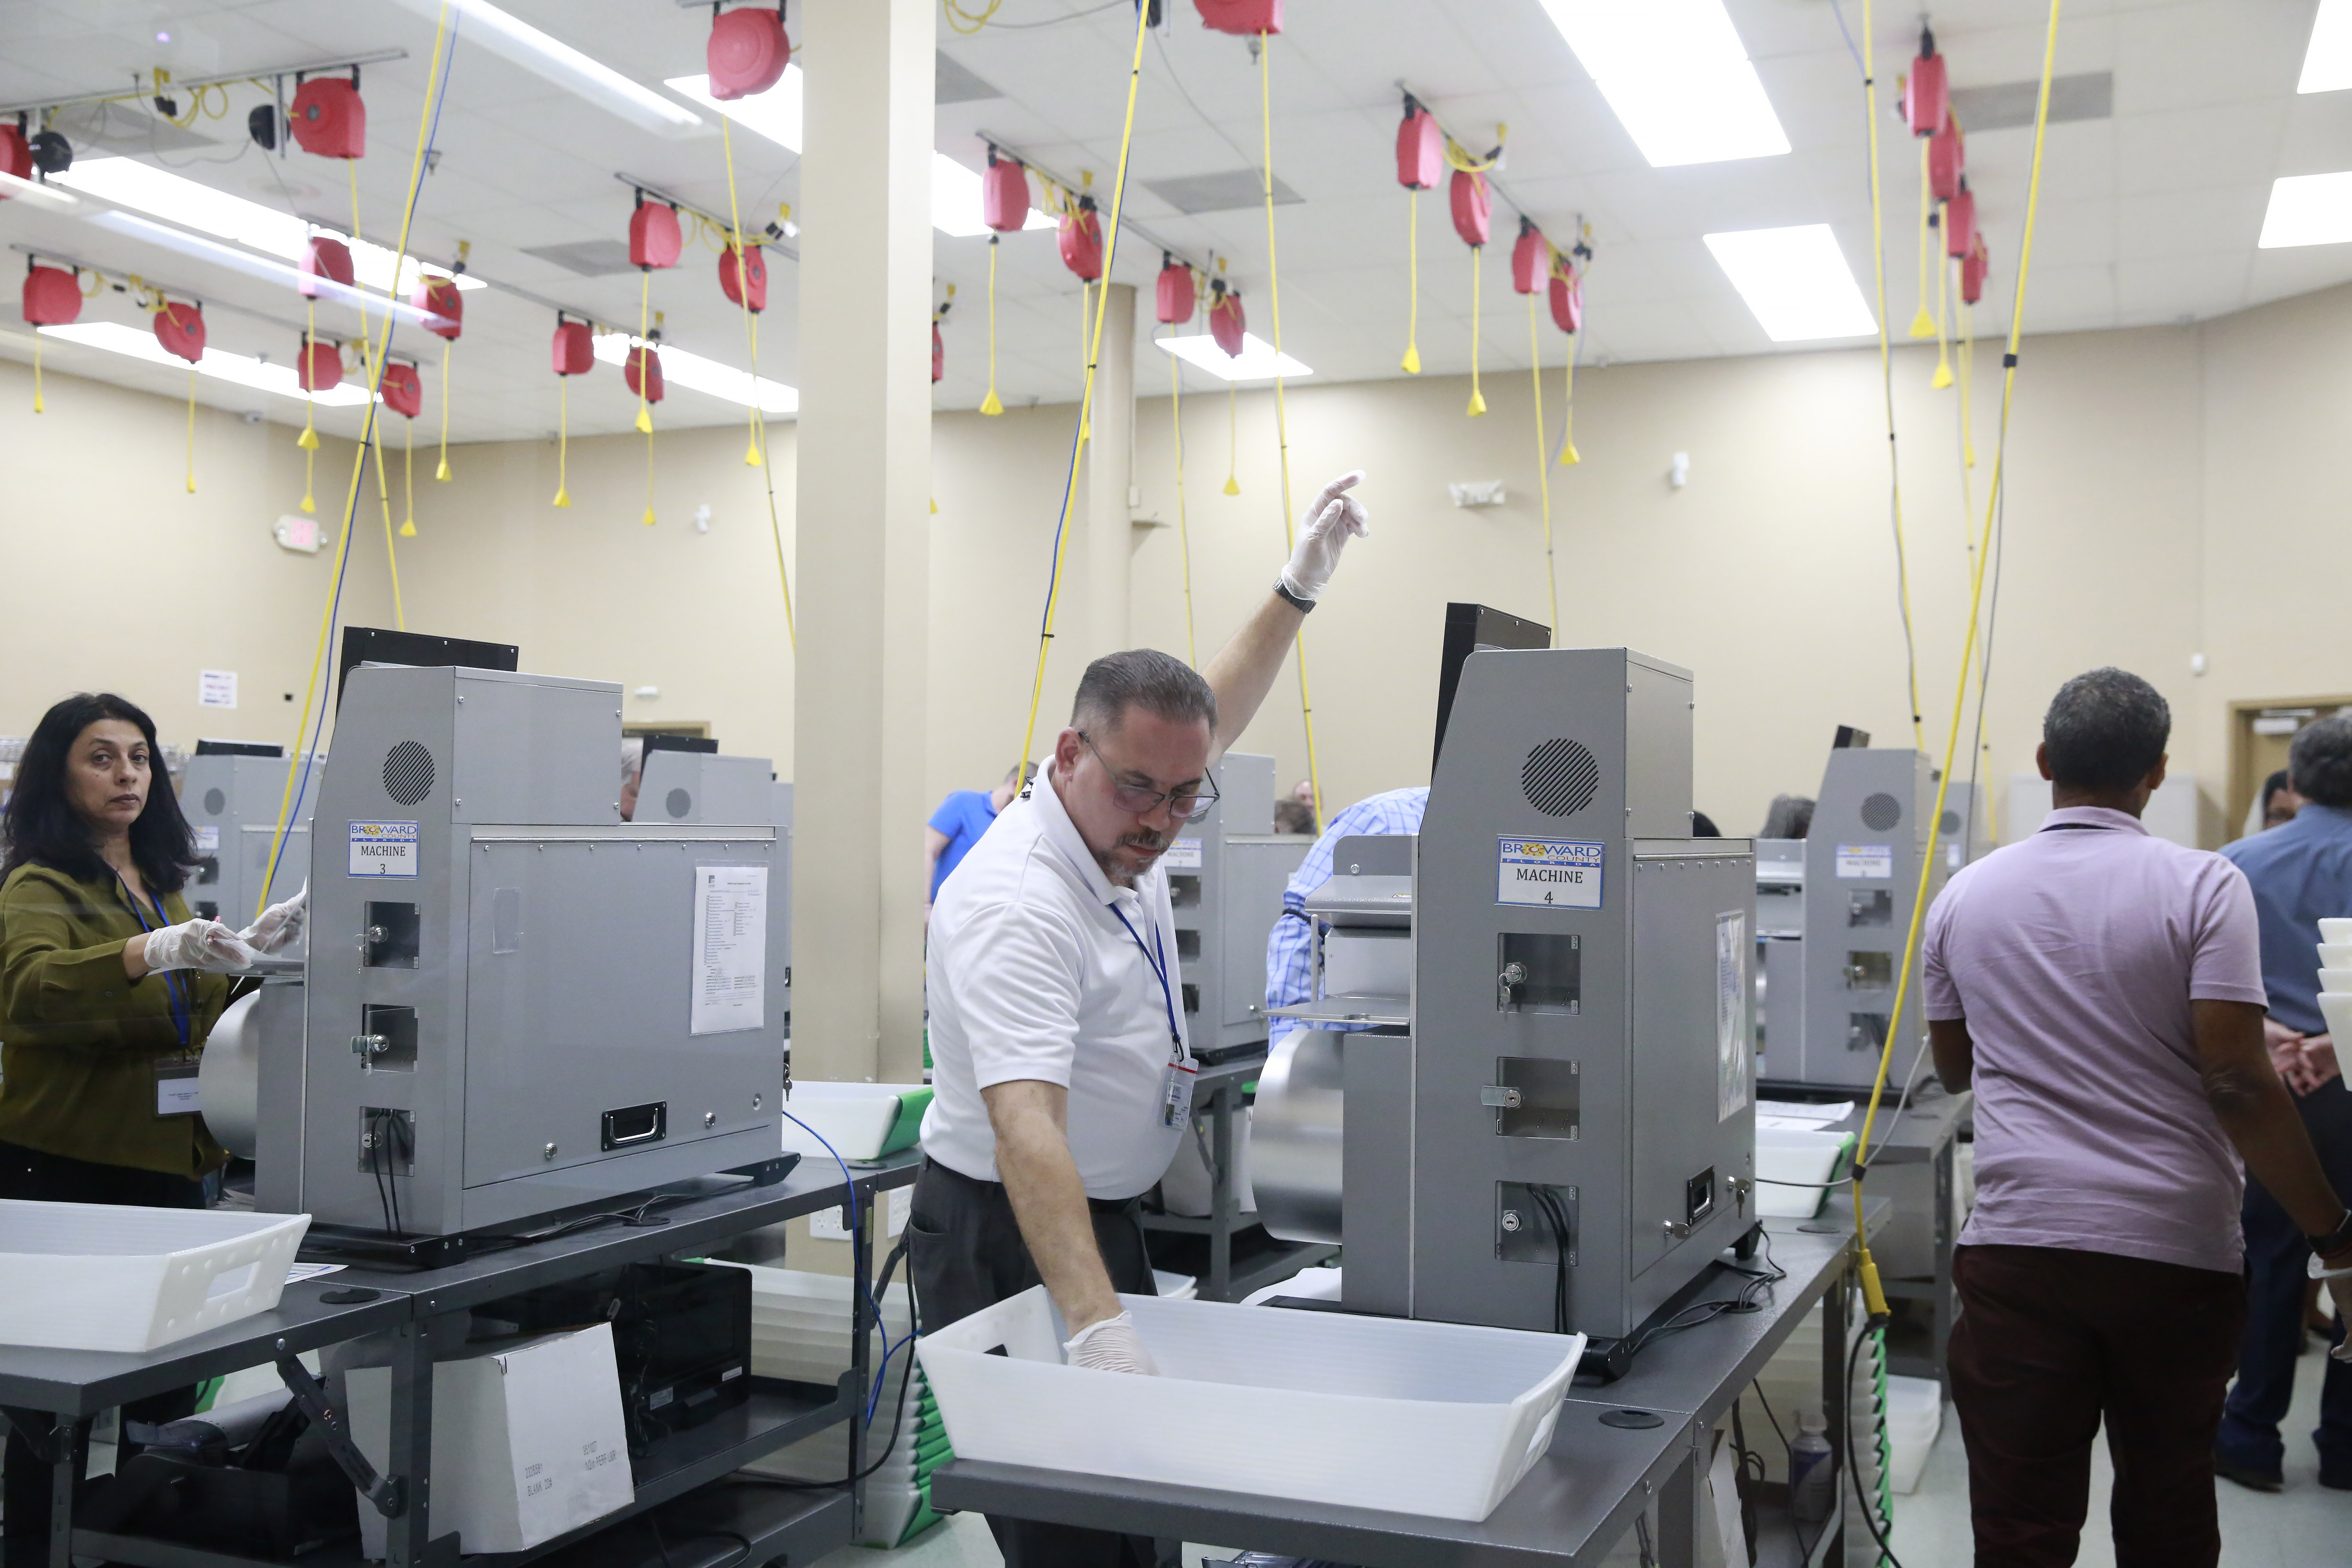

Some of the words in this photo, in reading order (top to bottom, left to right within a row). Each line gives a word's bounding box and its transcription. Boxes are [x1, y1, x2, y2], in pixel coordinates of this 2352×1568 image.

[352, 825, 416, 835] BROWARD
[361, 846, 405, 856] MACHINE
[1503, 843, 1601, 857] BROWARD
[1507, 859, 1596, 867] FLORIDA
[380, 864, 385, 874] 3
[1517, 868, 1583, 883] MACHINE
[1544, 891, 1553, 904] 4
[528, 1481, 542, 1497] BLANK
